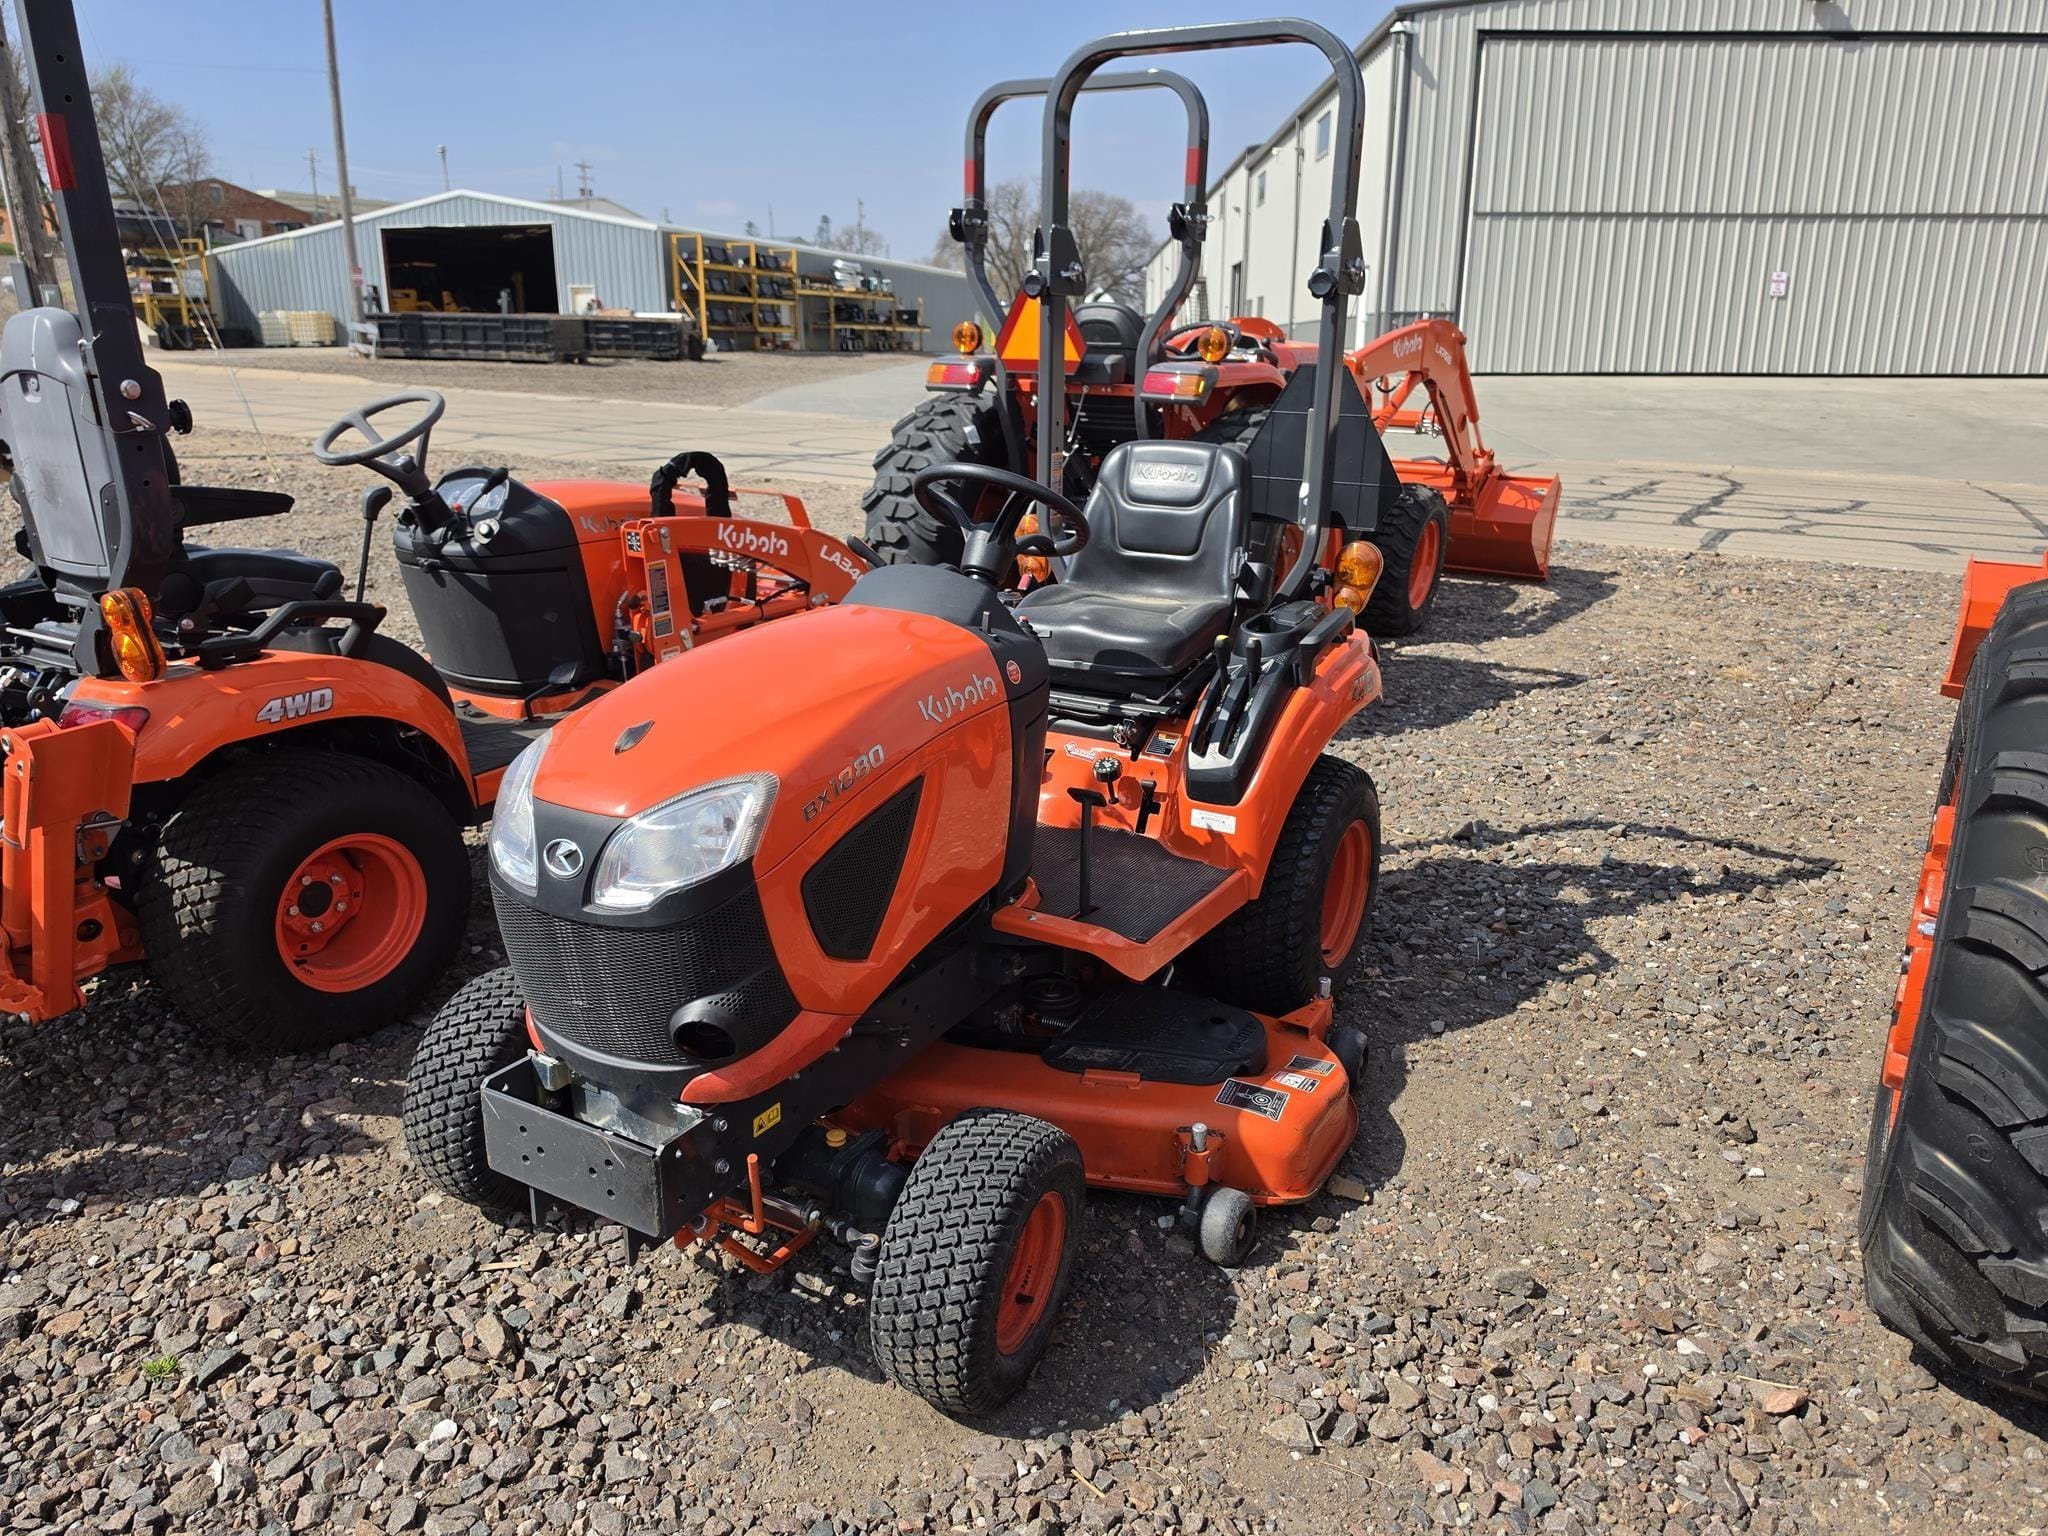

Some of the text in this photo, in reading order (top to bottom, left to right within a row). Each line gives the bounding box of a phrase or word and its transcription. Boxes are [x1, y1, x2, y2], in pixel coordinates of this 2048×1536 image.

[1137, 463, 1198, 483] Kubota
[718, 523, 788, 556] Kubota
[819, 544, 864, 582] LA34
[256, 687, 334, 724] 4WD
[917, 674, 998, 724] Kubota
[802, 743, 885, 823] BX1880
